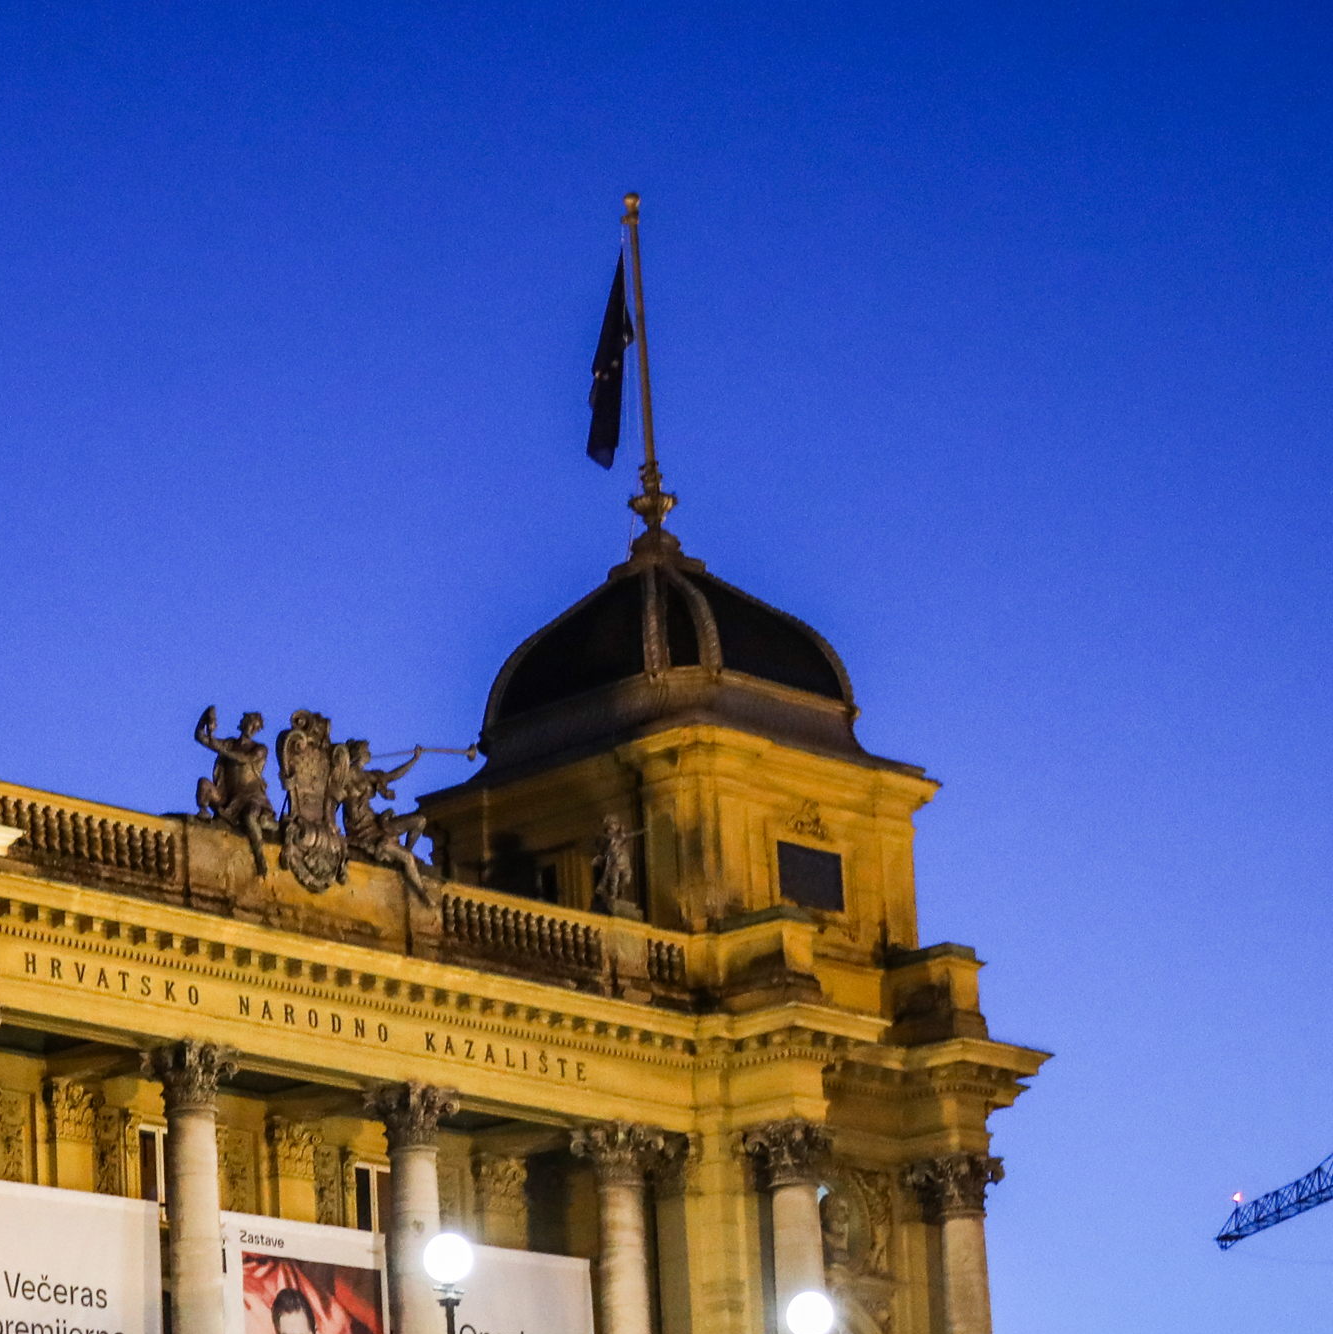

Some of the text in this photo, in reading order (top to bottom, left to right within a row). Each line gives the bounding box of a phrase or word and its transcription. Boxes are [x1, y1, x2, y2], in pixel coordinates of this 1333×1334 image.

[24, 952, 587, 1082] HRVATSKO NARODNO KAZALIŠTE
[239, 1229, 285, 1249] Zastave
[3, 1270, 108, 1309] Večeras
